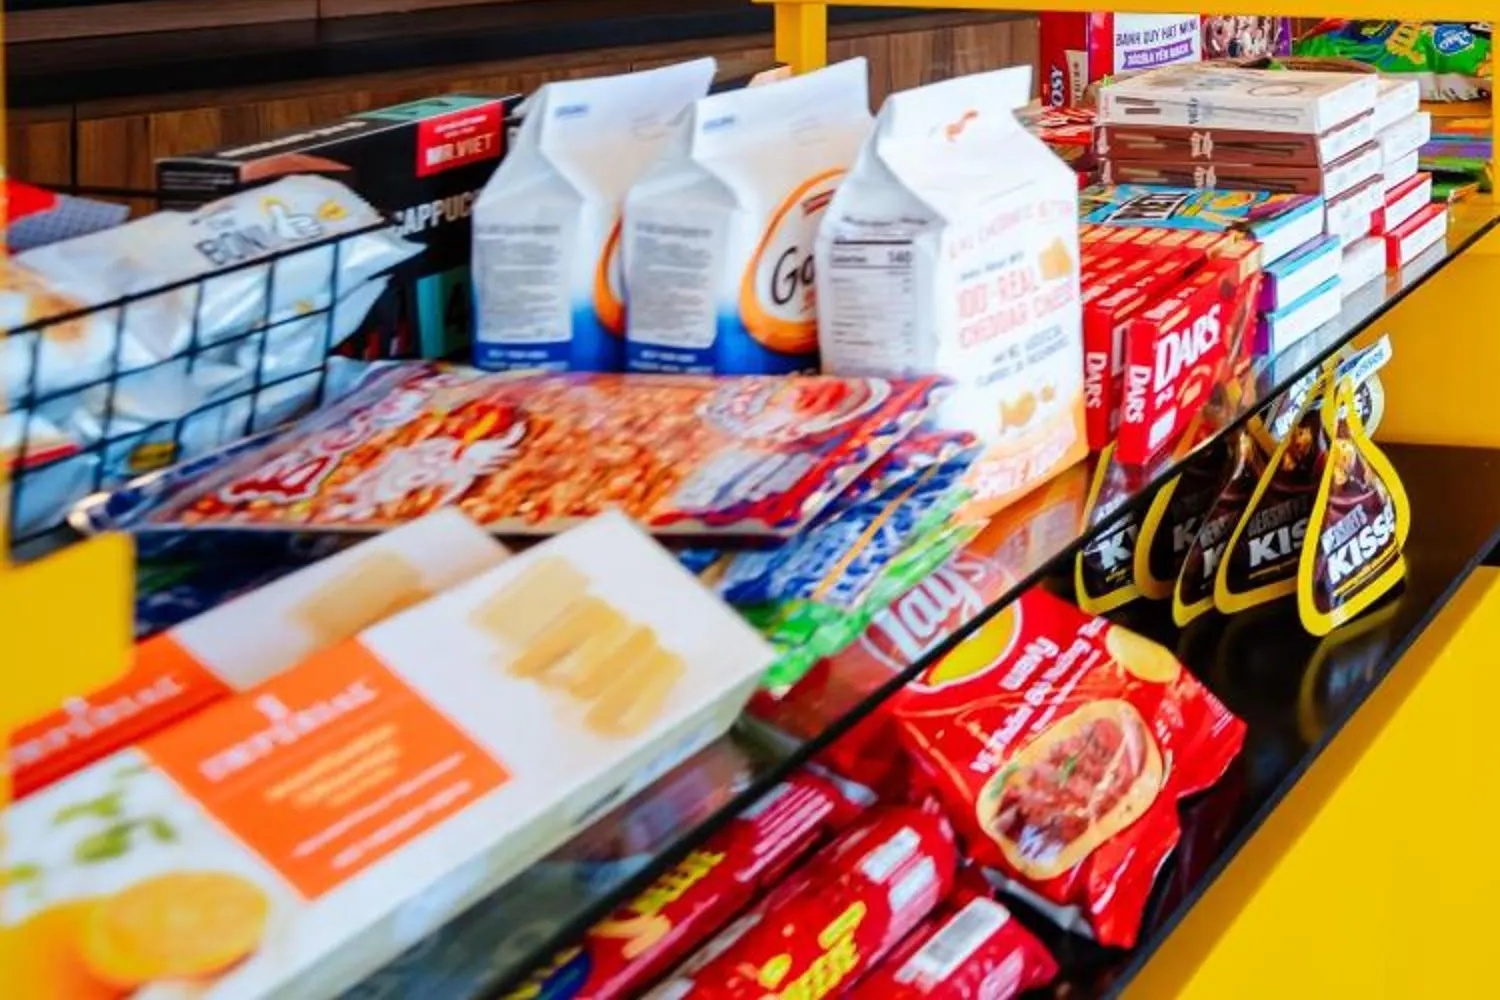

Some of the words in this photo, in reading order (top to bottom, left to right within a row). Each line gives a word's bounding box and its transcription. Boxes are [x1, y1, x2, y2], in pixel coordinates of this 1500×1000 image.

[1153, 303, 1222, 395] DARS
[1085, 351, 1108, 409] DARS
[1124, 364, 1152, 424] DARS
